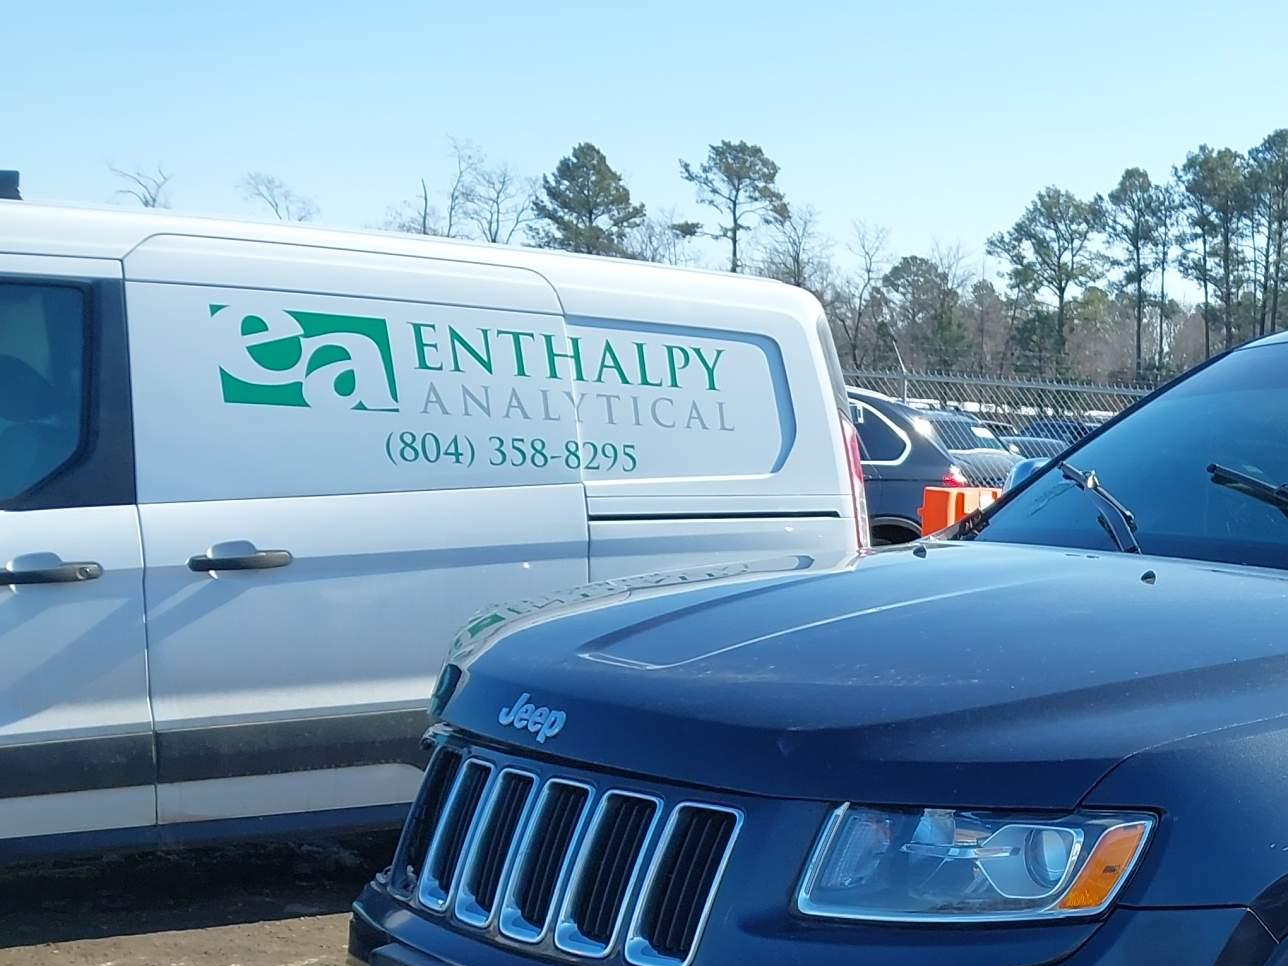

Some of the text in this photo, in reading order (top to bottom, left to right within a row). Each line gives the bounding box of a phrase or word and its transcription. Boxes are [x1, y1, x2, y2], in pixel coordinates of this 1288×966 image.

[408, 321, 725, 391] ENTHALPY
[420, 381, 736, 432] ANALYTICAL
[385, 431, 637, 472] (804) 358-8295
[499, 693, 566, 743] Jeep
